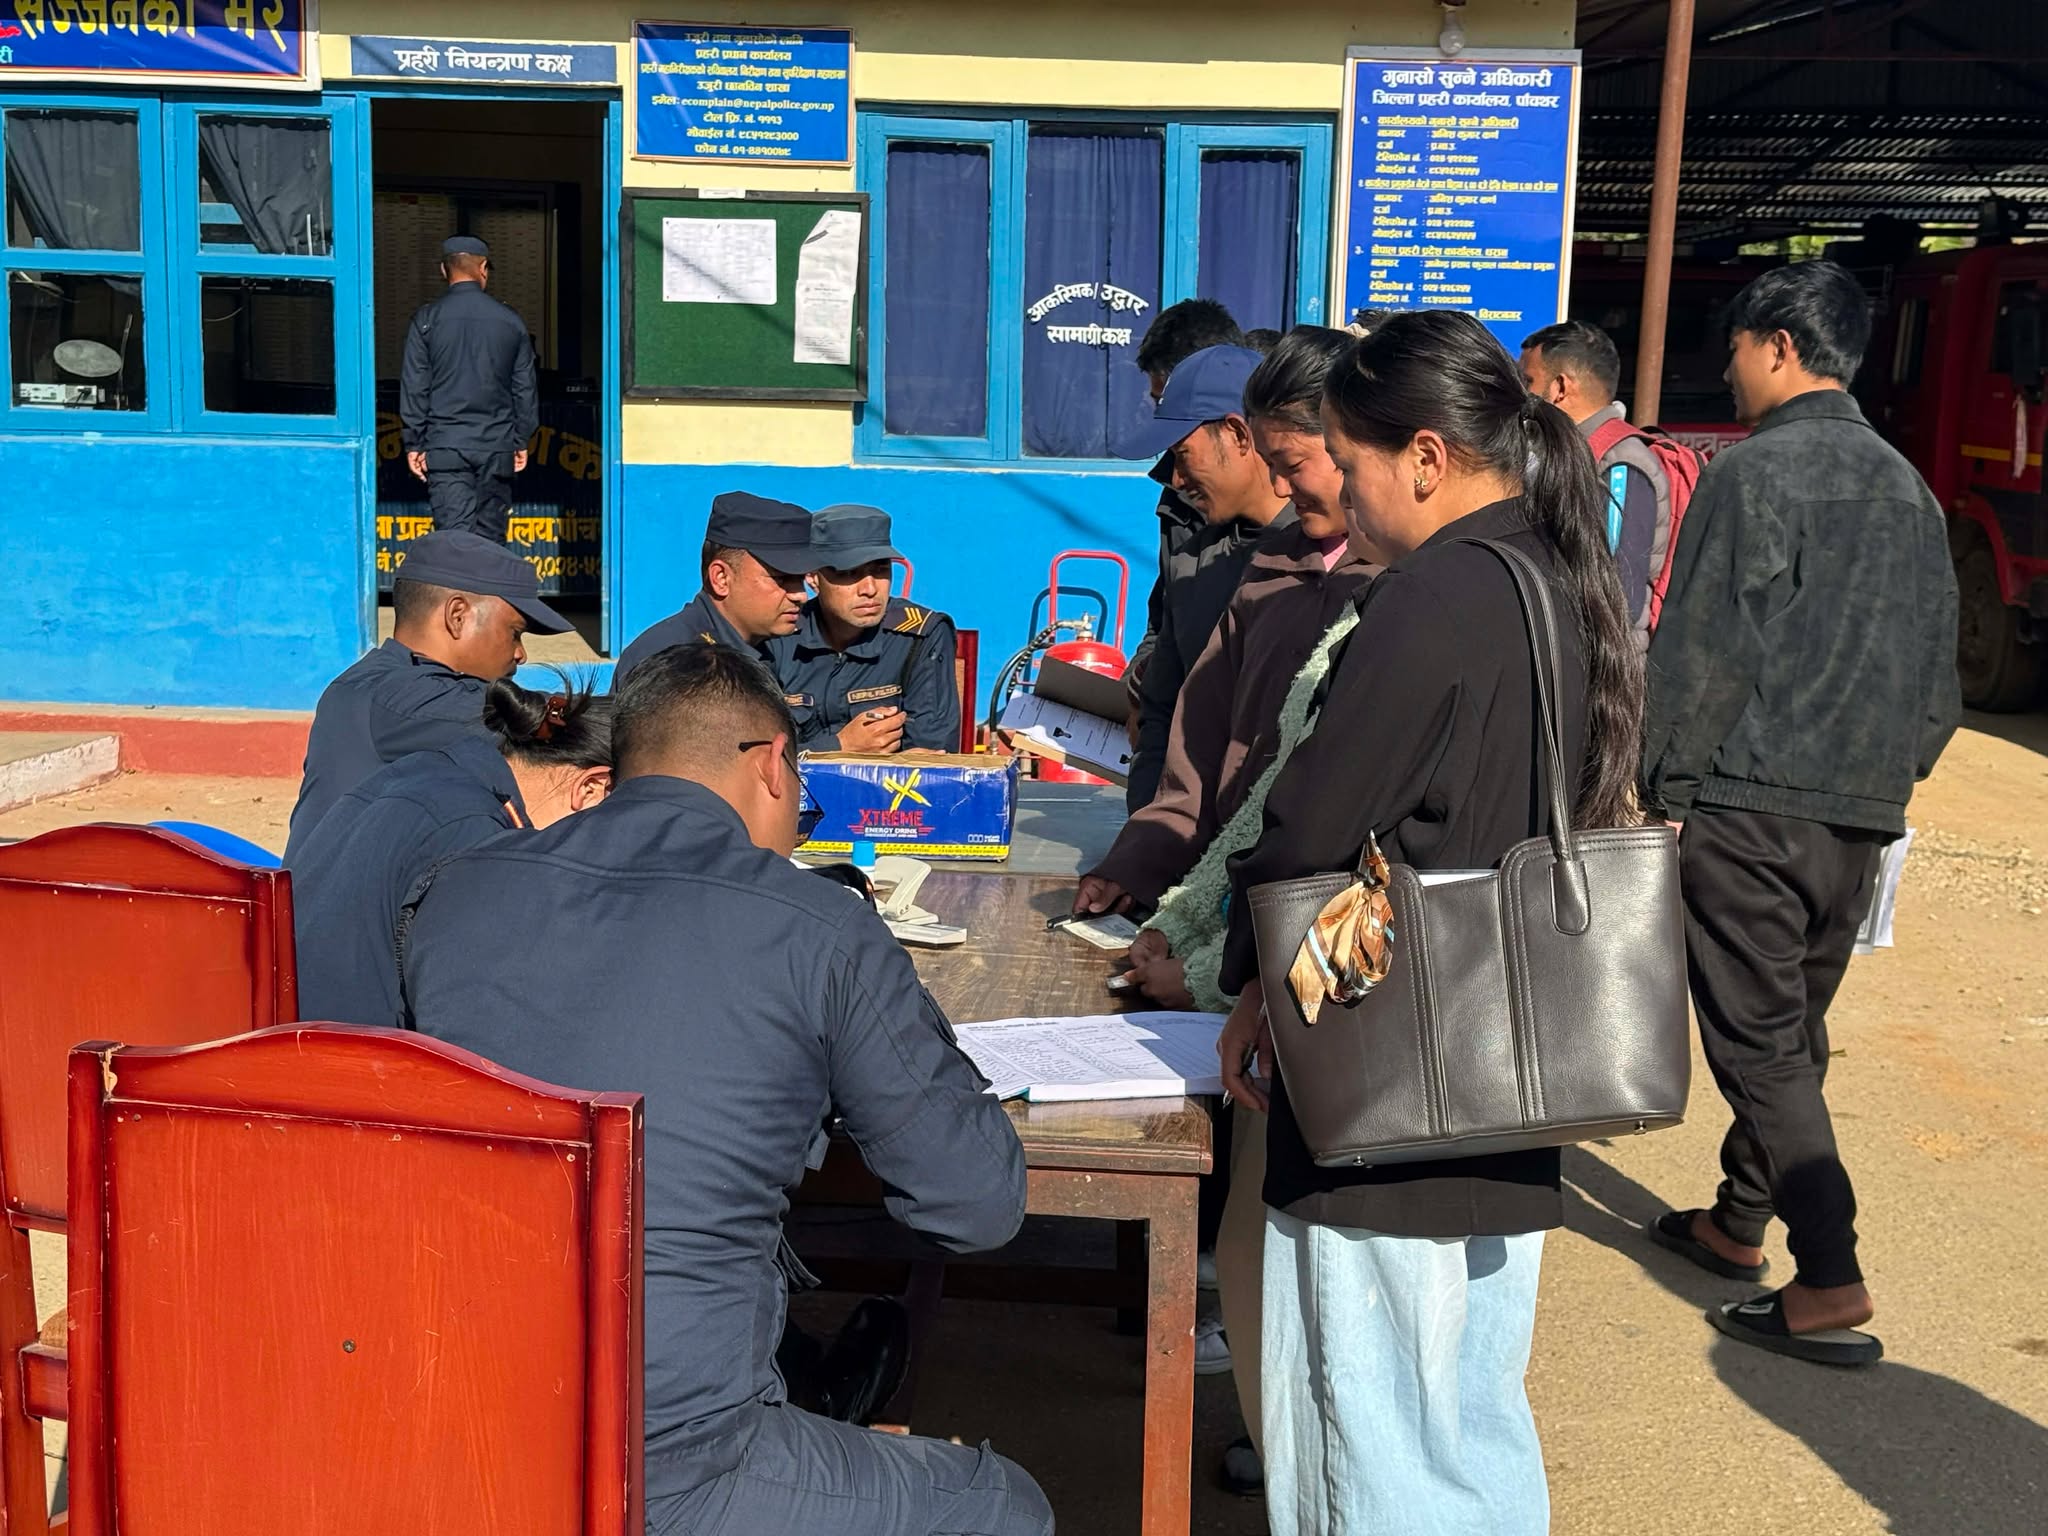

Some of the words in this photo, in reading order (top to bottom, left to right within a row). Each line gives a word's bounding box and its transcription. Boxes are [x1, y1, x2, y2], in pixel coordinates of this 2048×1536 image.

[695, 47, 720, 59] प्रहरी
[749, 50, 792, 61] कार्यालय
[394, 47, 438, 75] प्रहरी
[446, 46, 529, 72] नियन्त्रण
[535, 53, 574, 77] कक्ष
[1382, 67, 1435, 87] गुनासो
[1438, 68, 1477, 88] सुन्ने
[1481, 67, 1553, 87] अधिकारी
[696, 79, 723, 92] उजुरी
[681, 98, 835, 112] ecomplain@nepalpolice.gov.np
[1372, 90, 1415, 106] जिल्ला
[1417, 90, 1450, 107] प्रहरी
[703, 111, 723, 123] टोल
[695, 143, 718, 153] फोन
[859, 809, 924, 827] XTREME
